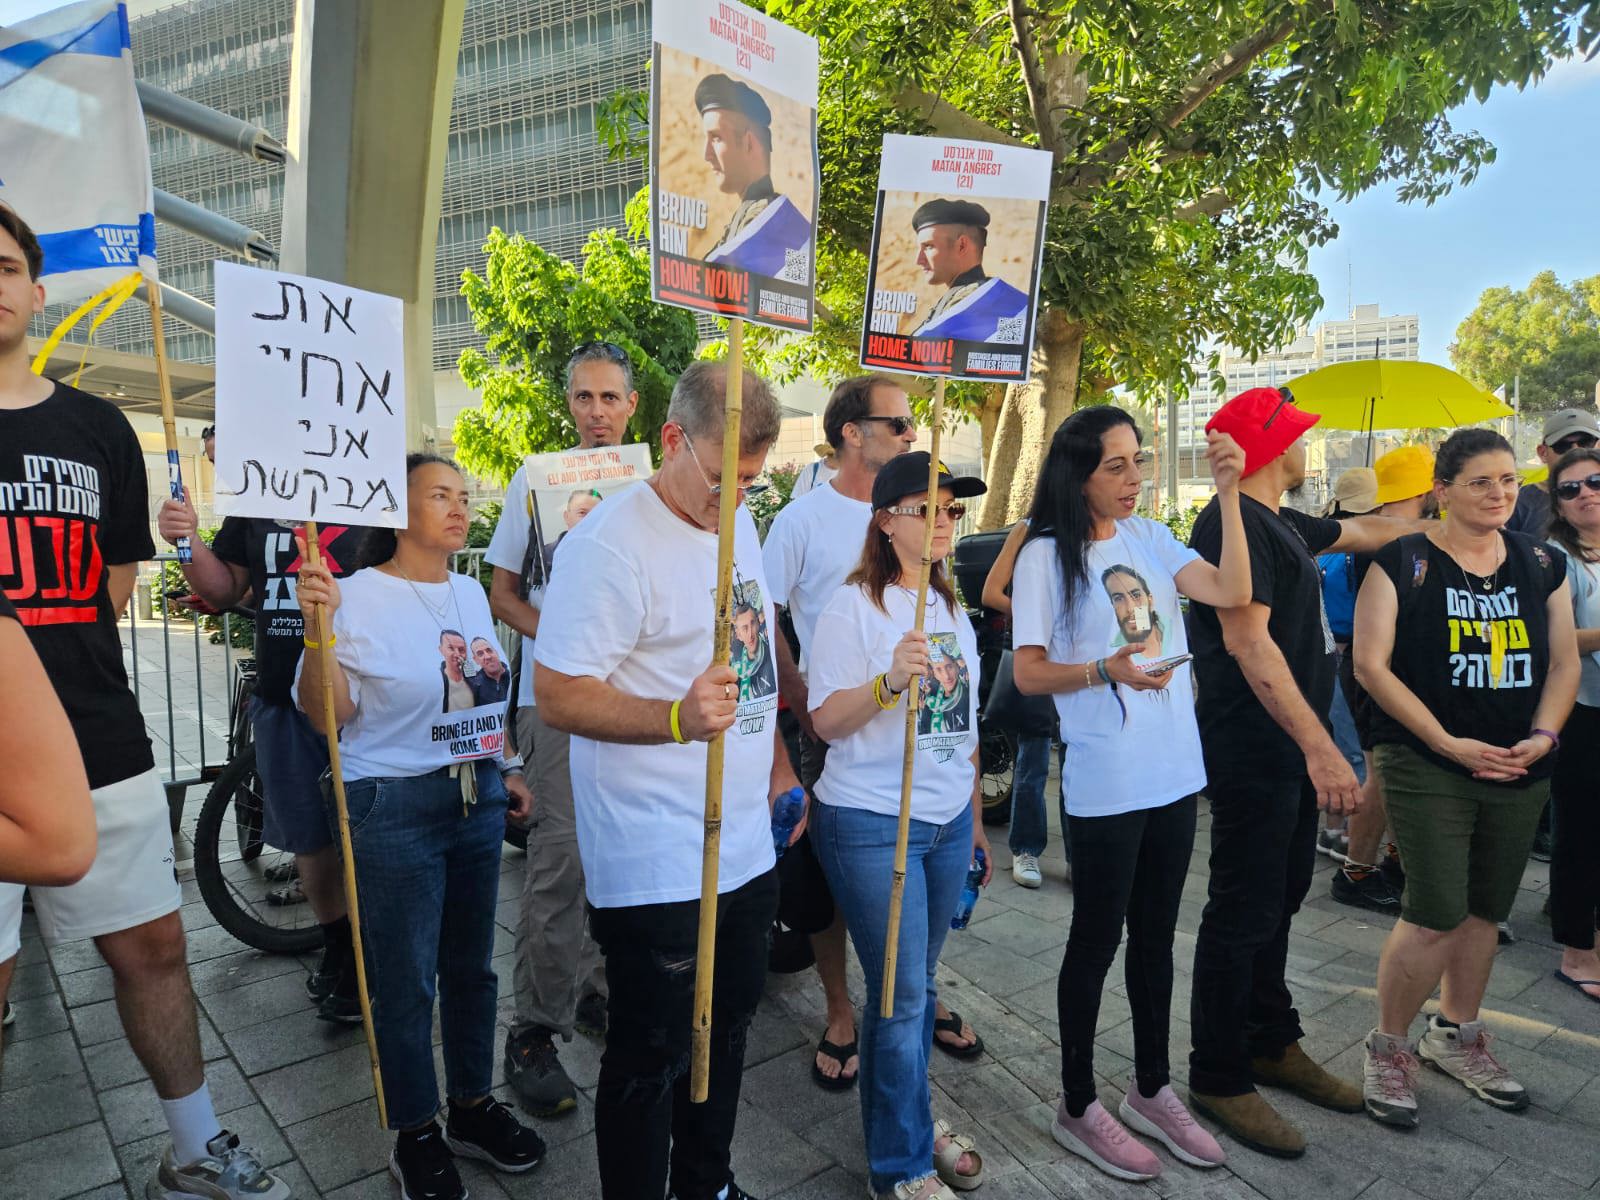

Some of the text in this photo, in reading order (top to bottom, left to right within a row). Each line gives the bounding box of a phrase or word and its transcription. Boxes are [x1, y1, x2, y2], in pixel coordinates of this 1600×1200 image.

[709, 15, 775, 63] MATAN ANGREST
[736, 47, 752, 72] (21)
[931, 159, 1002, 175] MATAN ANGREST
[957, 174, 974, 189] (21)
[659, 191, 707, 229] BRING
[659, 222, 688, 257] HIM
[659, 256, 749, 304] HOME NOW!
[252, 281, 356, 334] את
[872, 291, 916, 313] BRING
[870, 312, 898, 334] HIM
[867, 335, 954, 363] HOME NOW!
[258, 344, 393, 415] אחיי
[966, 359, 1021, 371] FAMILIES FORUM
[298, 419, 369, 459] אני
[23, 454, 100, 493] מחזירים
[216, 459, 398, 517] מבקשת
[547, 473, 559, 485] ELI
[561, 471, 577, 484] AND
[56, 484, 100, 520] אותם
[431, 722, 460, 742] BRING
[461, 719, 474, 736] ELI
[476, 715, 496, 733] AND
[450, 738, 480, 756] HOME
